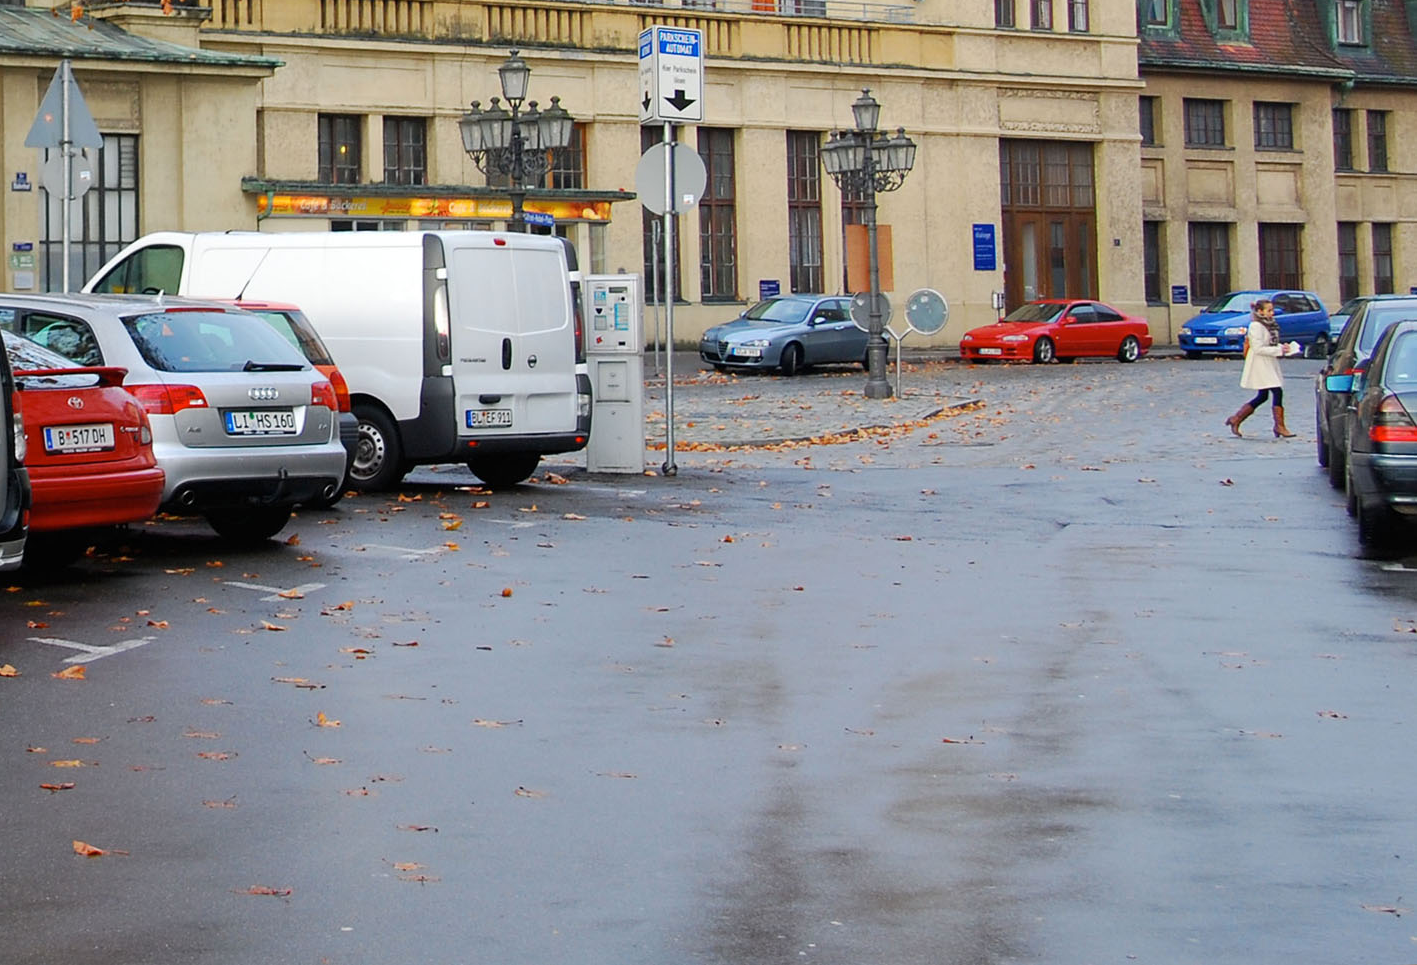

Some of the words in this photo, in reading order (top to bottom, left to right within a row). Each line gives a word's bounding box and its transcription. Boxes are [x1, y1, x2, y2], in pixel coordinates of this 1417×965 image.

[665, 43, 693, 55] AUTOMAT
[233, 414, 249, 429] LI
[257, 414, 272, 428] HS
[274, 413, 294, 428] 160
[498, 411, 511, 423] 911
[58, 430, 65, 446] B
[72, 429, 90, 445] 517
[93, 428, 107, 443] DH
